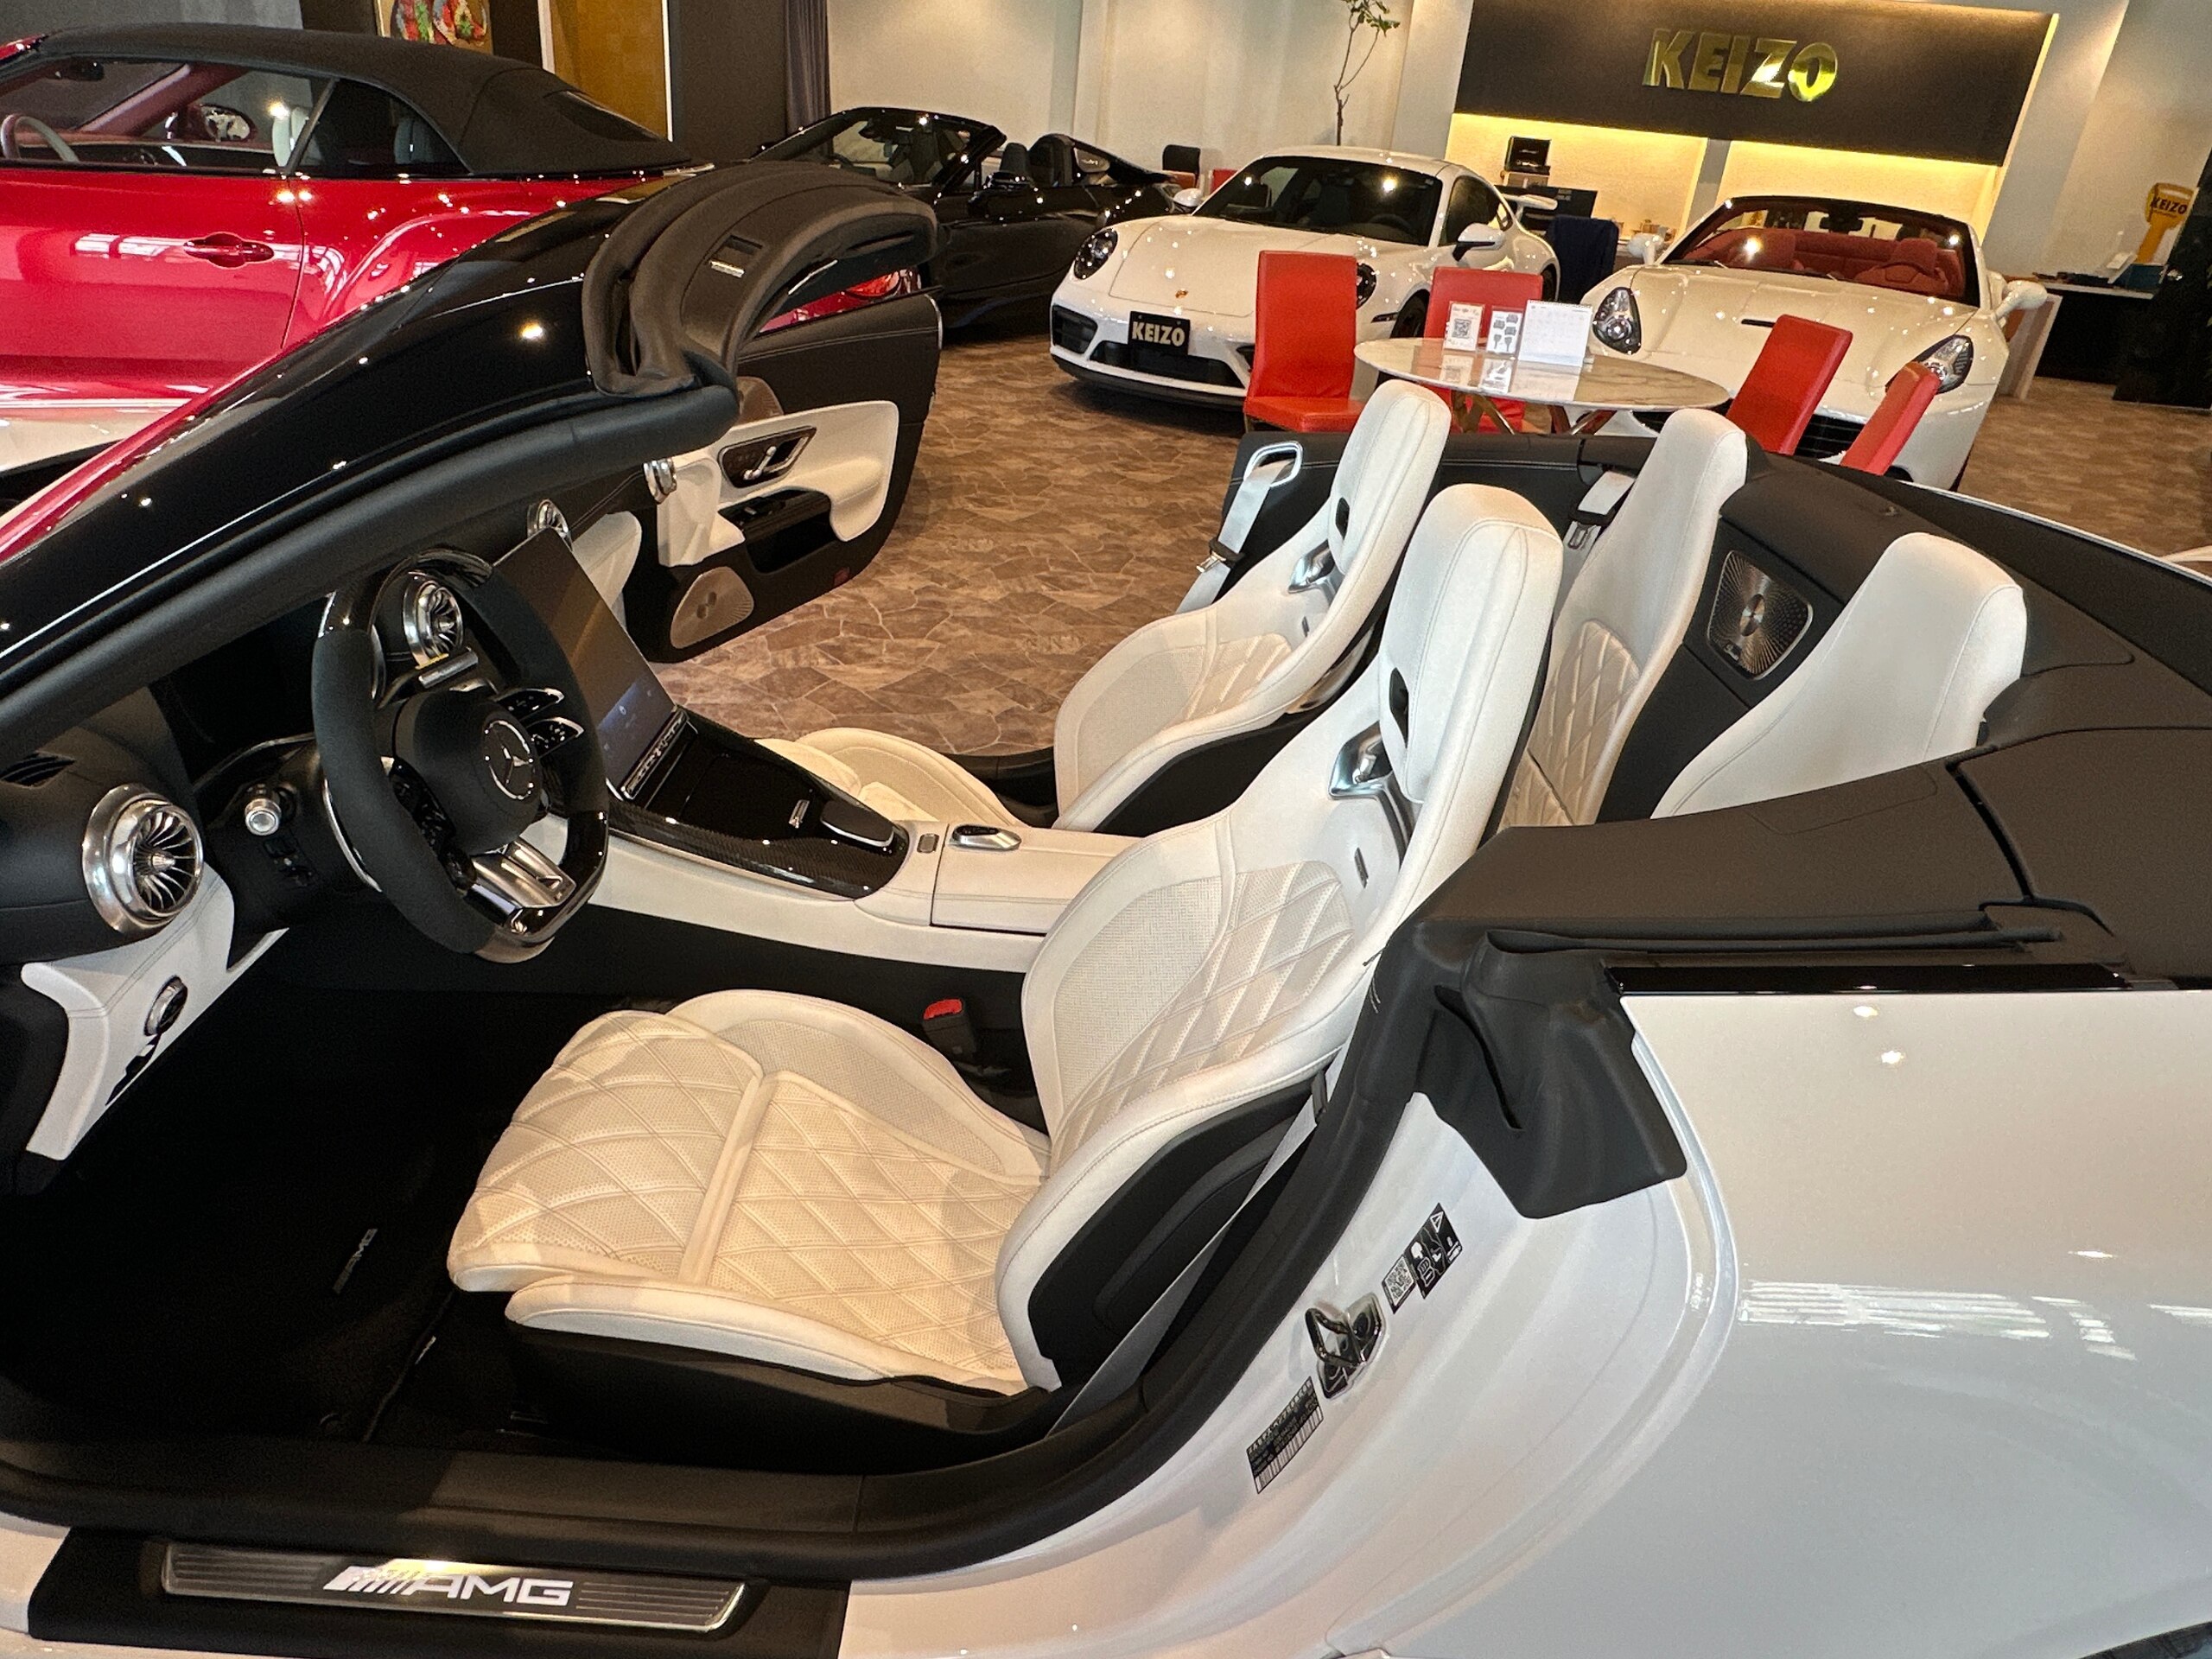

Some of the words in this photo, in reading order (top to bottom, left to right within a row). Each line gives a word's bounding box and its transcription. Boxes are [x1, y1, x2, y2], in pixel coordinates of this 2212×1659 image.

[1642, 29, 1839, 102] KEIZO
[2150, 195, 2188, 214] KEIZO
[1131, 321, 1185, 347] KEIZO
[406, 1573, 574, 1607] AMG
